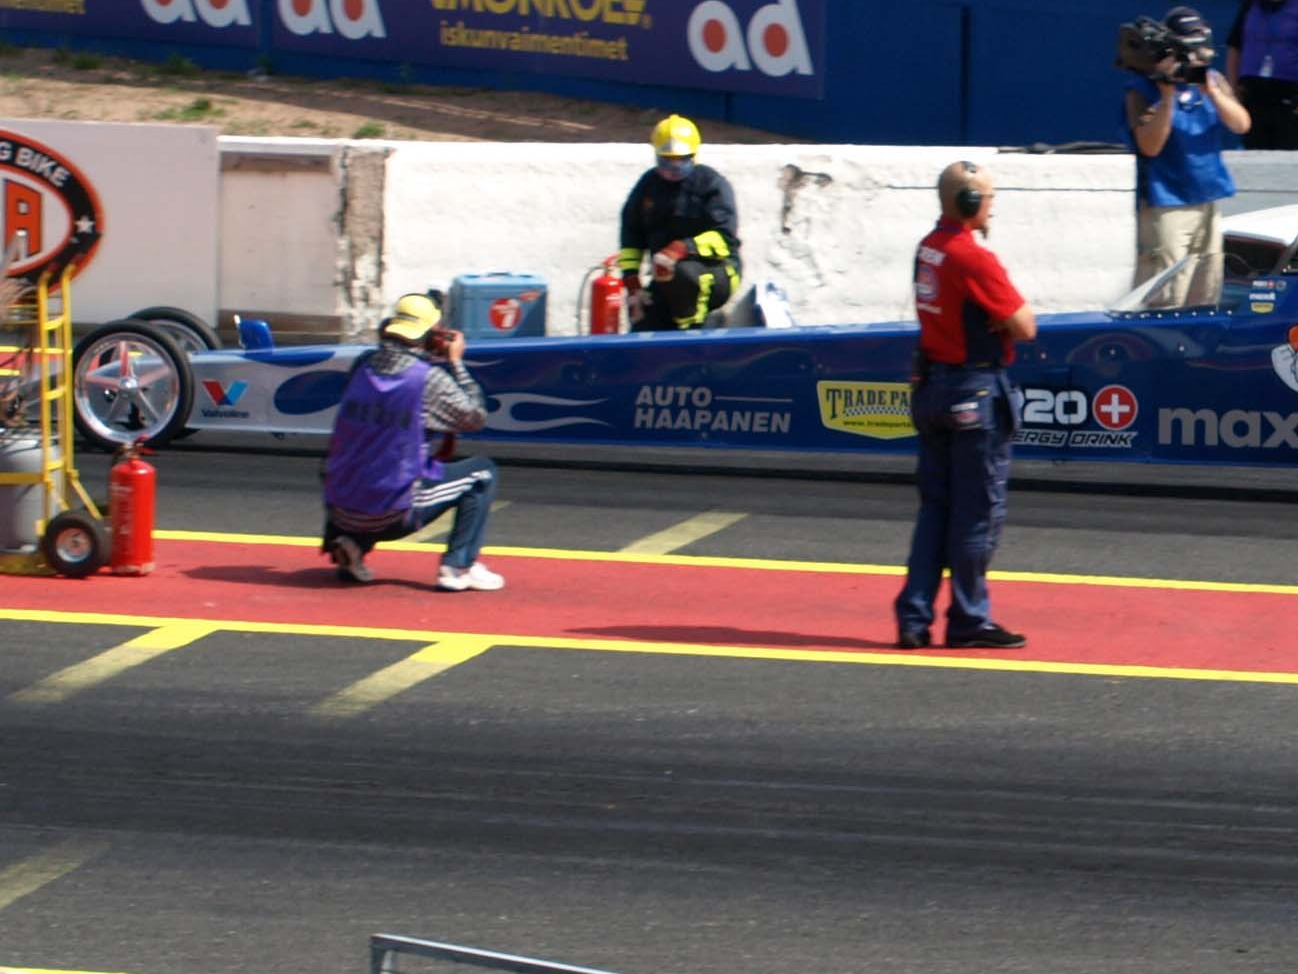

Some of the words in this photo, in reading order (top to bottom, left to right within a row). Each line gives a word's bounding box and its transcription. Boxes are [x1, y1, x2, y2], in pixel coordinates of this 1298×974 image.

[15, 146, 71, 187] BIKE
[635, 385, 713, 408] AUTO
[826, 388, 887, 421] TRADE
[634, 407, 792, 434] HAAPANEN
[1068, 430, 1135, 448] DRINK
